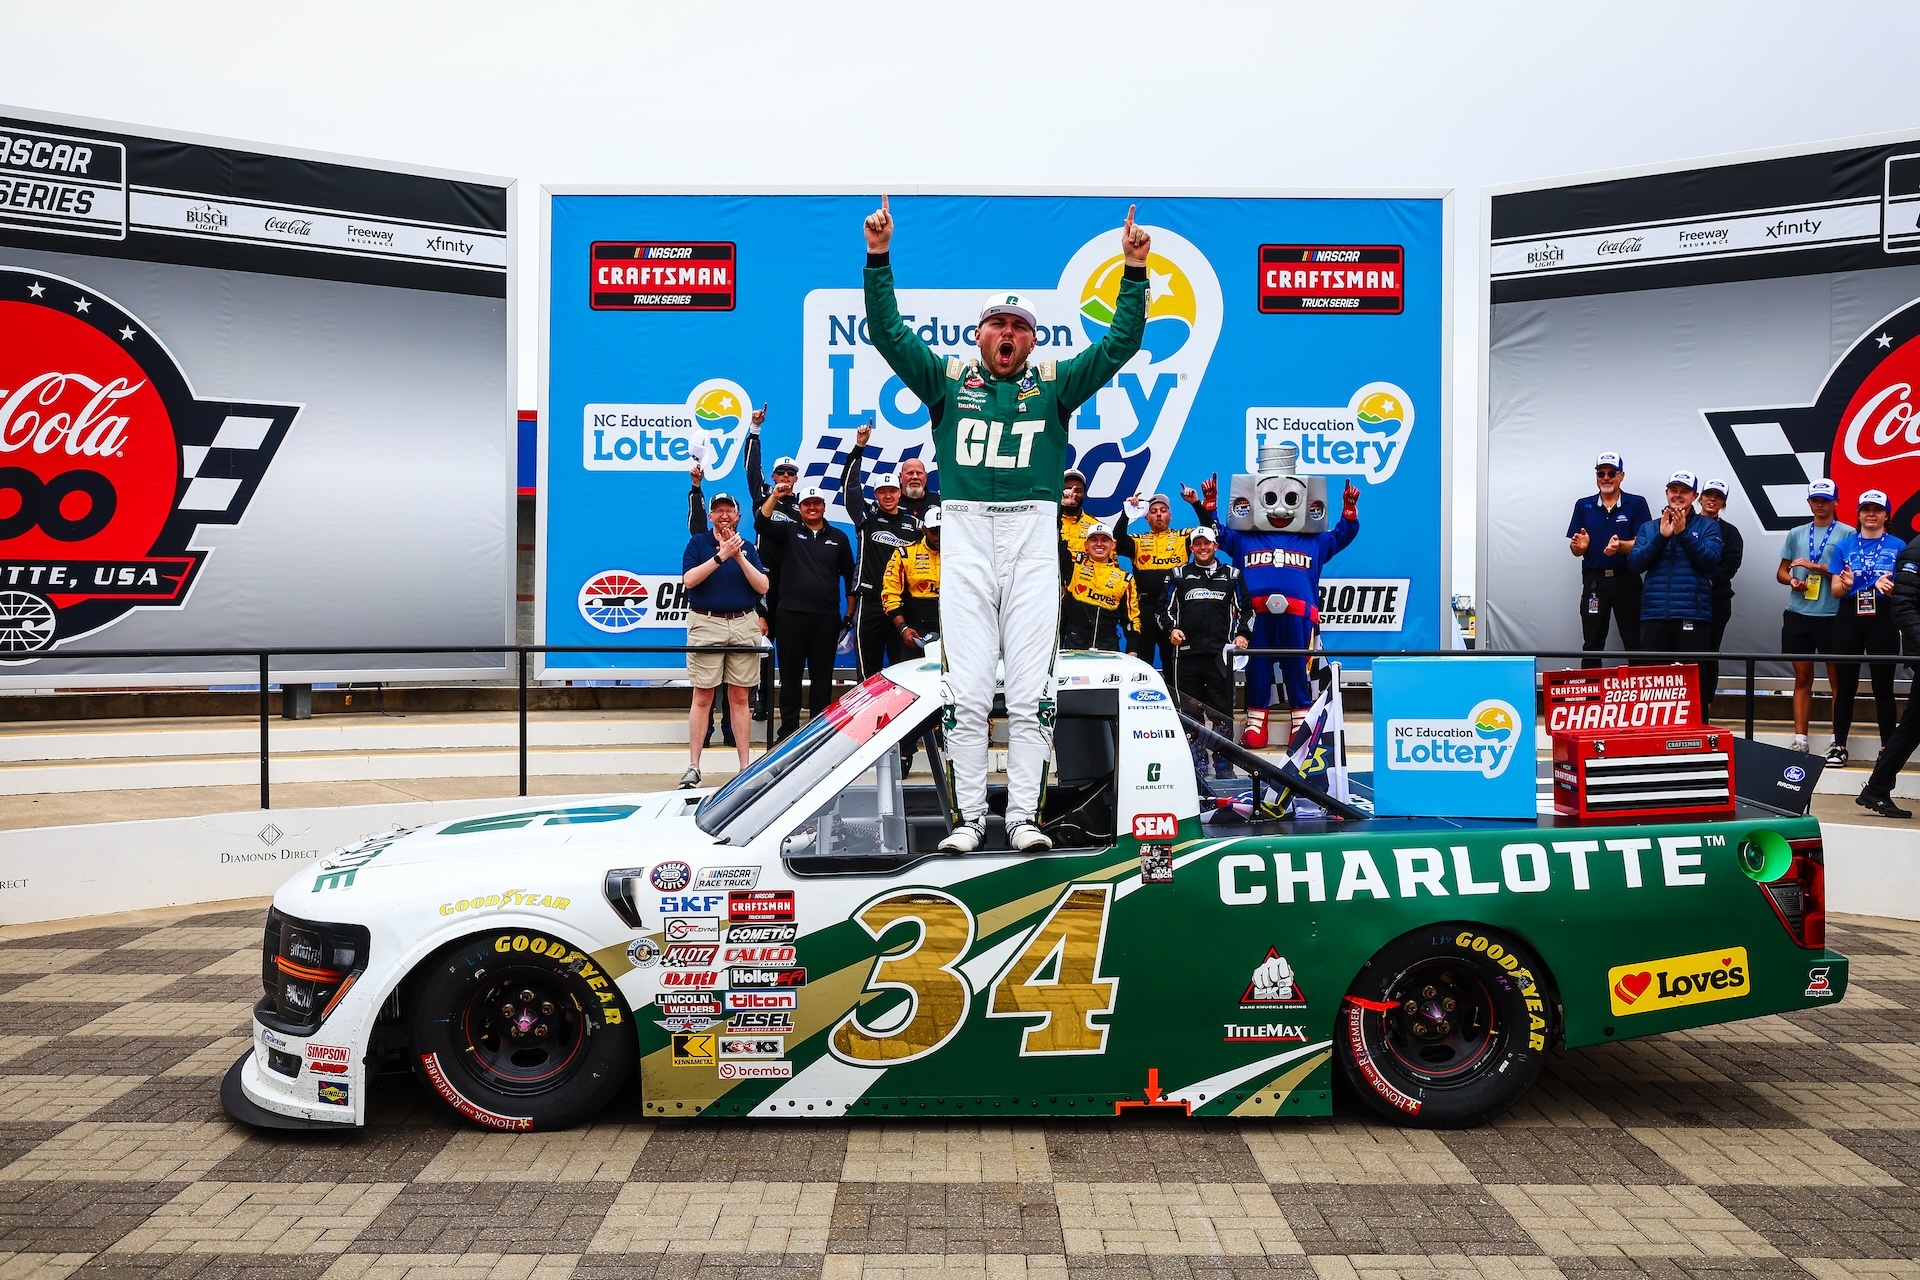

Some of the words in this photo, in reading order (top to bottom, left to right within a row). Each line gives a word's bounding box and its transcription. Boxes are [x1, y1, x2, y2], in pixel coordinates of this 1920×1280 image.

[0, 180, 95, 214] SERIES
[186, 210, 229, 227] BUSCH
[195, 223, 219, 231] LIGHT
[265, 216, 313, 236] Coca-Cola
[1765, 218, 1822, 238] xfinity
[347, 225, 394, 242] Freeway
[1679, 228, 1729, 242] Freeway
[347, 237, 394, 247] INSURANCE
[426, 236, 474, 256] xfinity
[1597, 237, 1644, 256] Coca-Cola
[1679, 239, 1729, 249] INSURANCE
[648, 247, 692, 259] NASCAR
[1316, 250, 1360, 262] NASCAR
[1527, 249, 1564, 264] BUSCH
[598, 267, 727, 286] CRAFTSMAN
[1266, 270, 1395, 289] CRAFTSMAN
[901, 315, 1073, 346] Educon
[593, 414, 617, 428] NC
[621, 414, 692, 428] Education
[1256, 417, 1279, 431] NC
[1283, 417, 1354, 431] Education
[956, 418, 1046, 469] CLT
[593, 430, 735, 475] Lottey
[1244, 552, 1273, 568] LUG
[1286, 552, 1313, 568] NUT
[0, 566, 78, 588] TTE,
[94, 567, 158, 585] USA
[1319, 586, 1399, 612] RLOTTE
[656, 611, 690, 621] MOT
[1319, 615, 1395, 624] SPEEDWAY
[1603, 675, 1684, 690] CRAFTSMAN
[1136, 690, 1161, 701] Ford
[1550, 686, 1599, 695] CRAFTSMAN
[1604, 690, 1638, 703] 2026
[1640, 687, 1688, 701] WINNER
[1550, 701, 1691, 731] CHARLOTTE
[1133, 730, 1164, 739] Mobil
[1165, 730, 1175, 738] 1
[1395, 727, 1413, 737] NC
[1416, 727, 1473, 738] Education
[1667, 740, 1700, 748] CRAFTSMAN
[1395, 739, 1508, 771] Lottery
[1776, 780, 1801, 792] RACING
[1135, 816, 1176, 836] SEM
[656, 863, 686, 873] NASCAR
[717, 869, 751, 878] NASCAR
[1217, 836, 1707, 906] CHARLOTTE
[655, 878, 686, 889] SALUTES
[439, 890, 571, 916] GOODYEAR
[660, 896, 724, 912] SKF
[732, 902, 791, 911] CRAFTSMAN
[667, 925, 717, 934] XCELDYNE
[729, 928, 795, 940] COMETIC
[630, 939, 656, 948] CHAMPION
[631, 956, 657, 967] IRRIGATION
[668, 947, 716, 962] KLOTZ
[724, 948, 794, 961] CALICO
[494, 935, 623, 1025] GOODYEAR
[664, 972, 718, 985] DART
[733, 970, 778, 987] Holley
[828, 883, 1119, 1067] 34
[1455, 931, 1546, 1051] GOODYEAR
[657, 994, 710, 1004] LINCOLN
[729, 994, 792, 1007] tilton
[728, 1013, 793, 1027] JESEL
[307, 1045, 347, 1061] SIMPSON
[310, 1062, 349, 1073] ARP
[739, 1066, 790, 1076] brembo
[1364, 1065, 1375, 1078] AND
[425, 1056, 463, 1108] REMEMBER
[1373, 1079, 1407, 1109] HONOR
[461, 1104, 474, 1114] AND
[475, 1111, 516, 1130] HONOR
